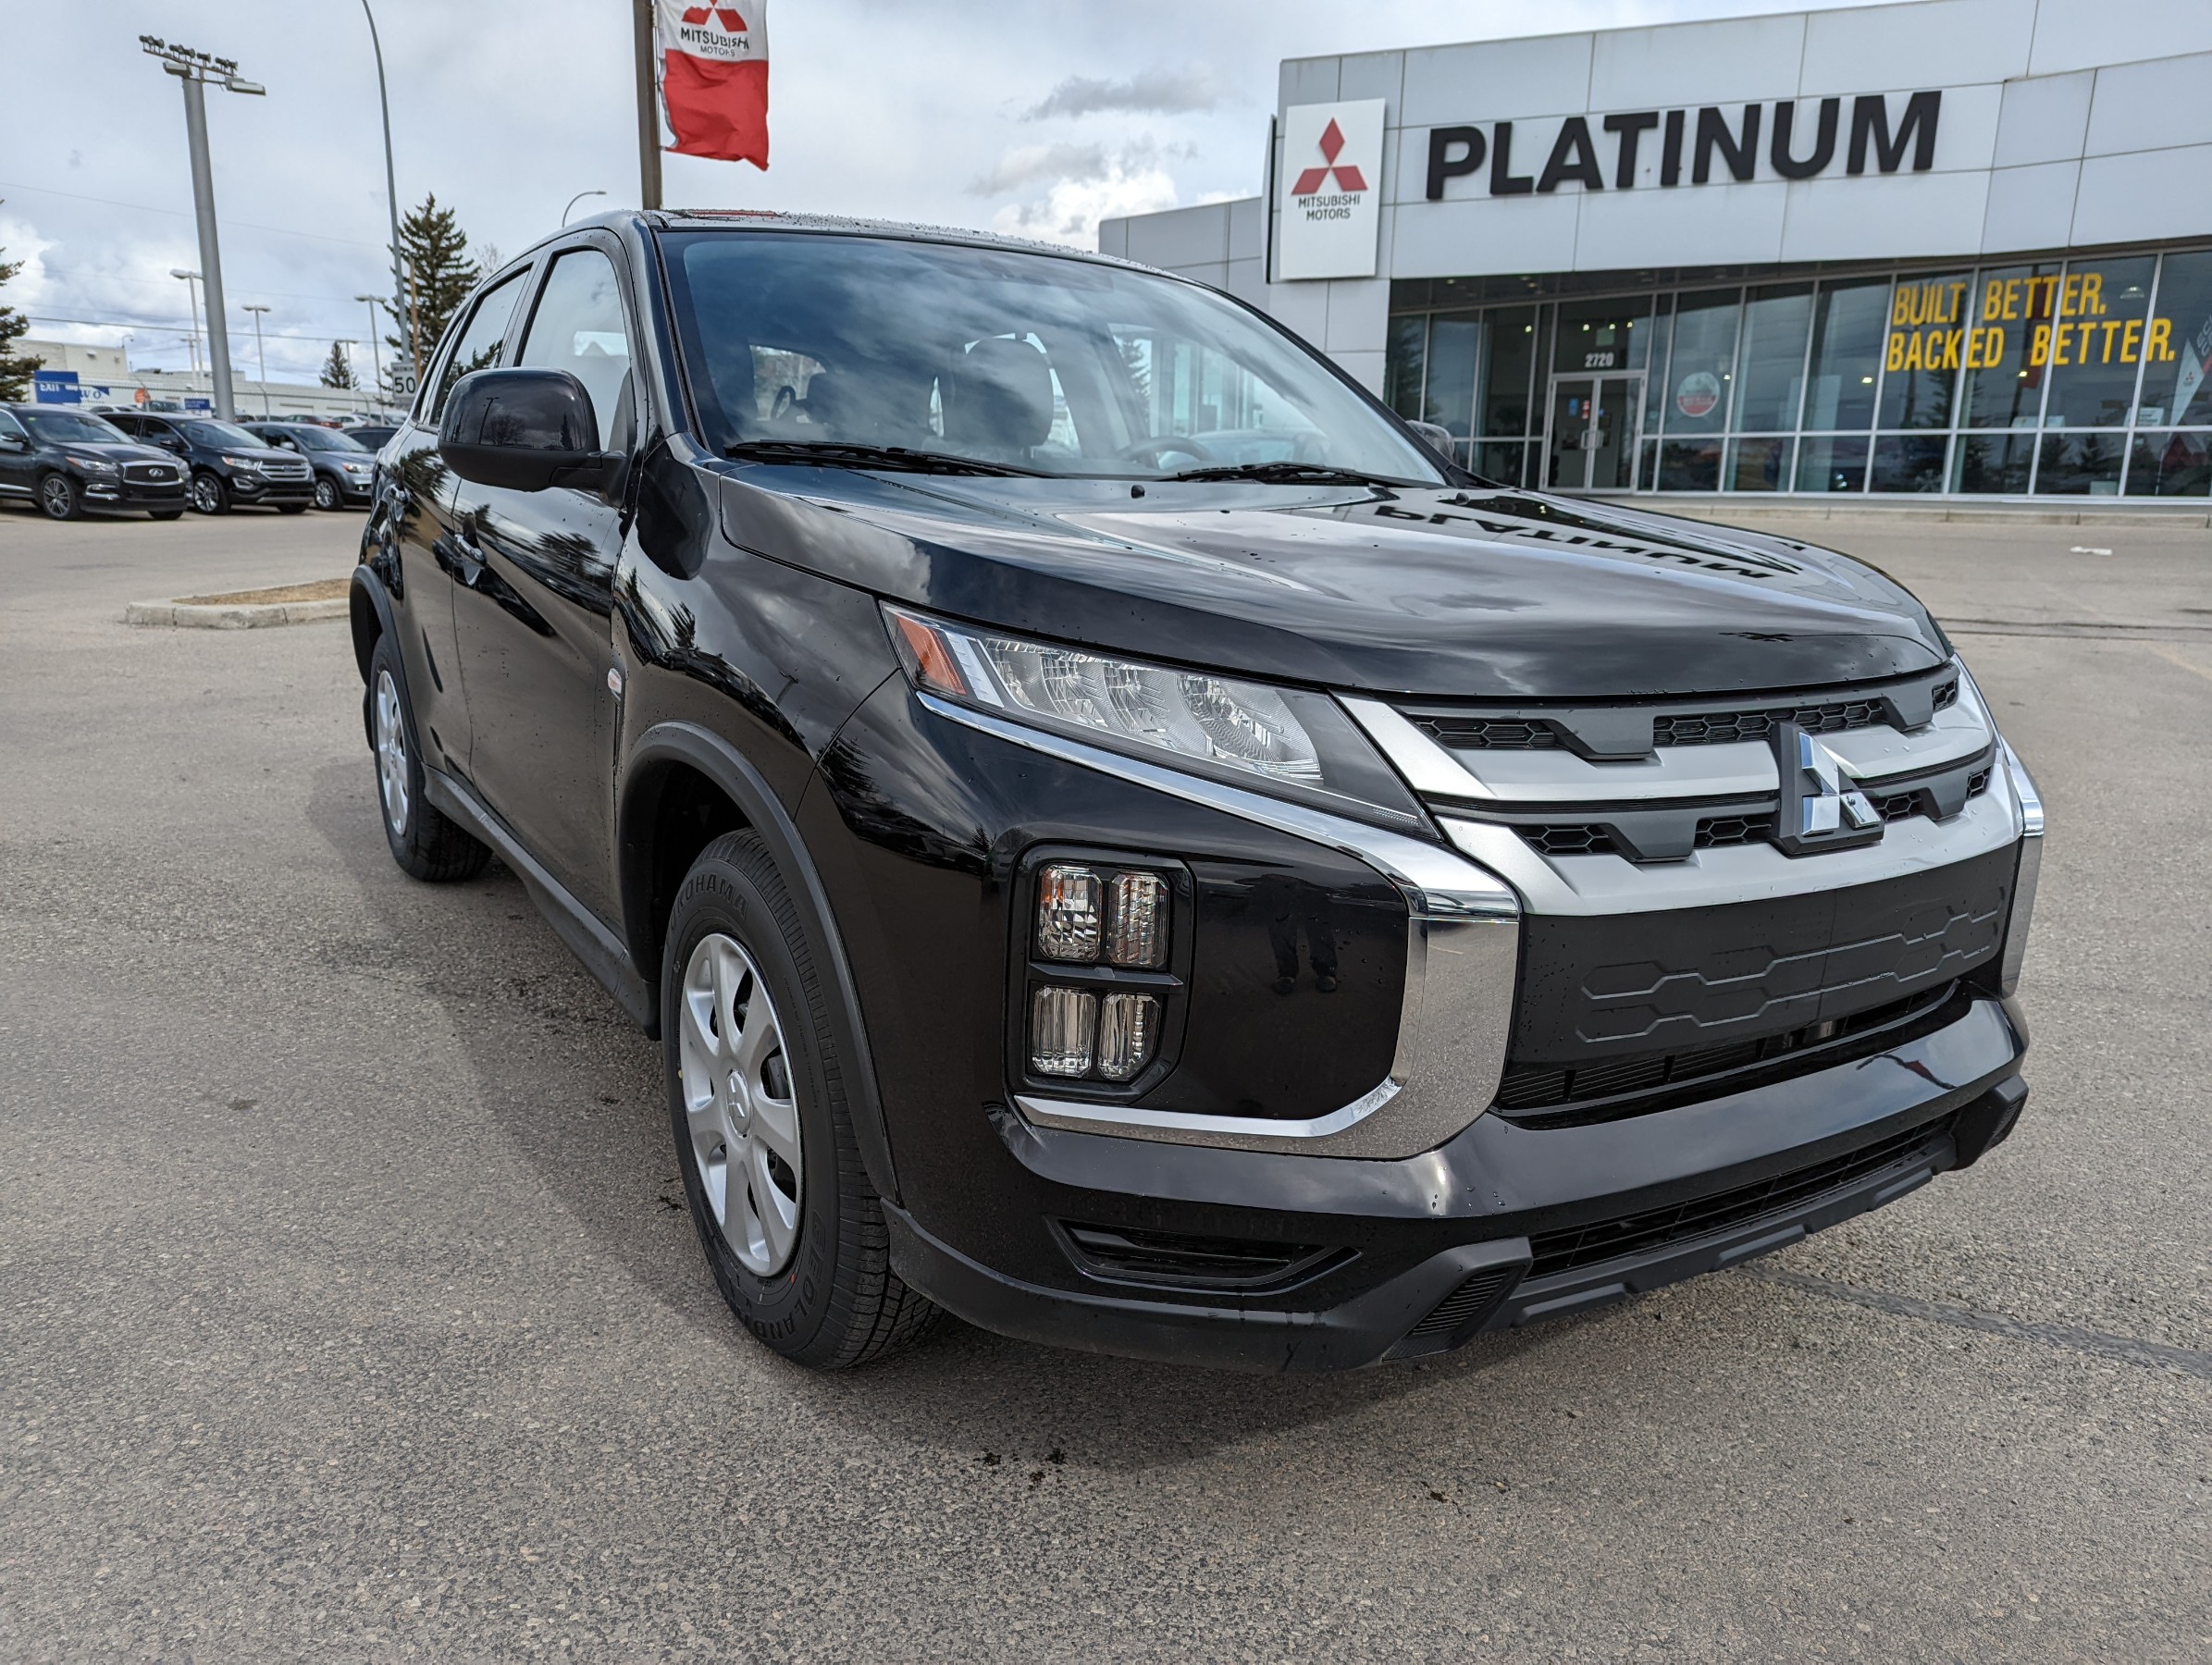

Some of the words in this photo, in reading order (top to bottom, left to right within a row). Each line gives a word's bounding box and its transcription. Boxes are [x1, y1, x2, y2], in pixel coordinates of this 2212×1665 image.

[700, 45, 735, 57] MOTORS
[1426, 90, 1943, 201] PLATINUM
[1297, 193, 1361, 209] MITSUBISHI
[1306, 207, 1351, 222] MOTORS
[1892, 281, 1966, 327] BUILT
[1983, 273, 2107, 322] BETTER.
[1886, 326, 2005, 372] BACKED
[2030, 317, 2176, 367] BETTER.
[1584, 352, 1614, 368] 2720
[394, 376, 416, 394] 50
[740, 1208, 826, 1340] GEOLAND
